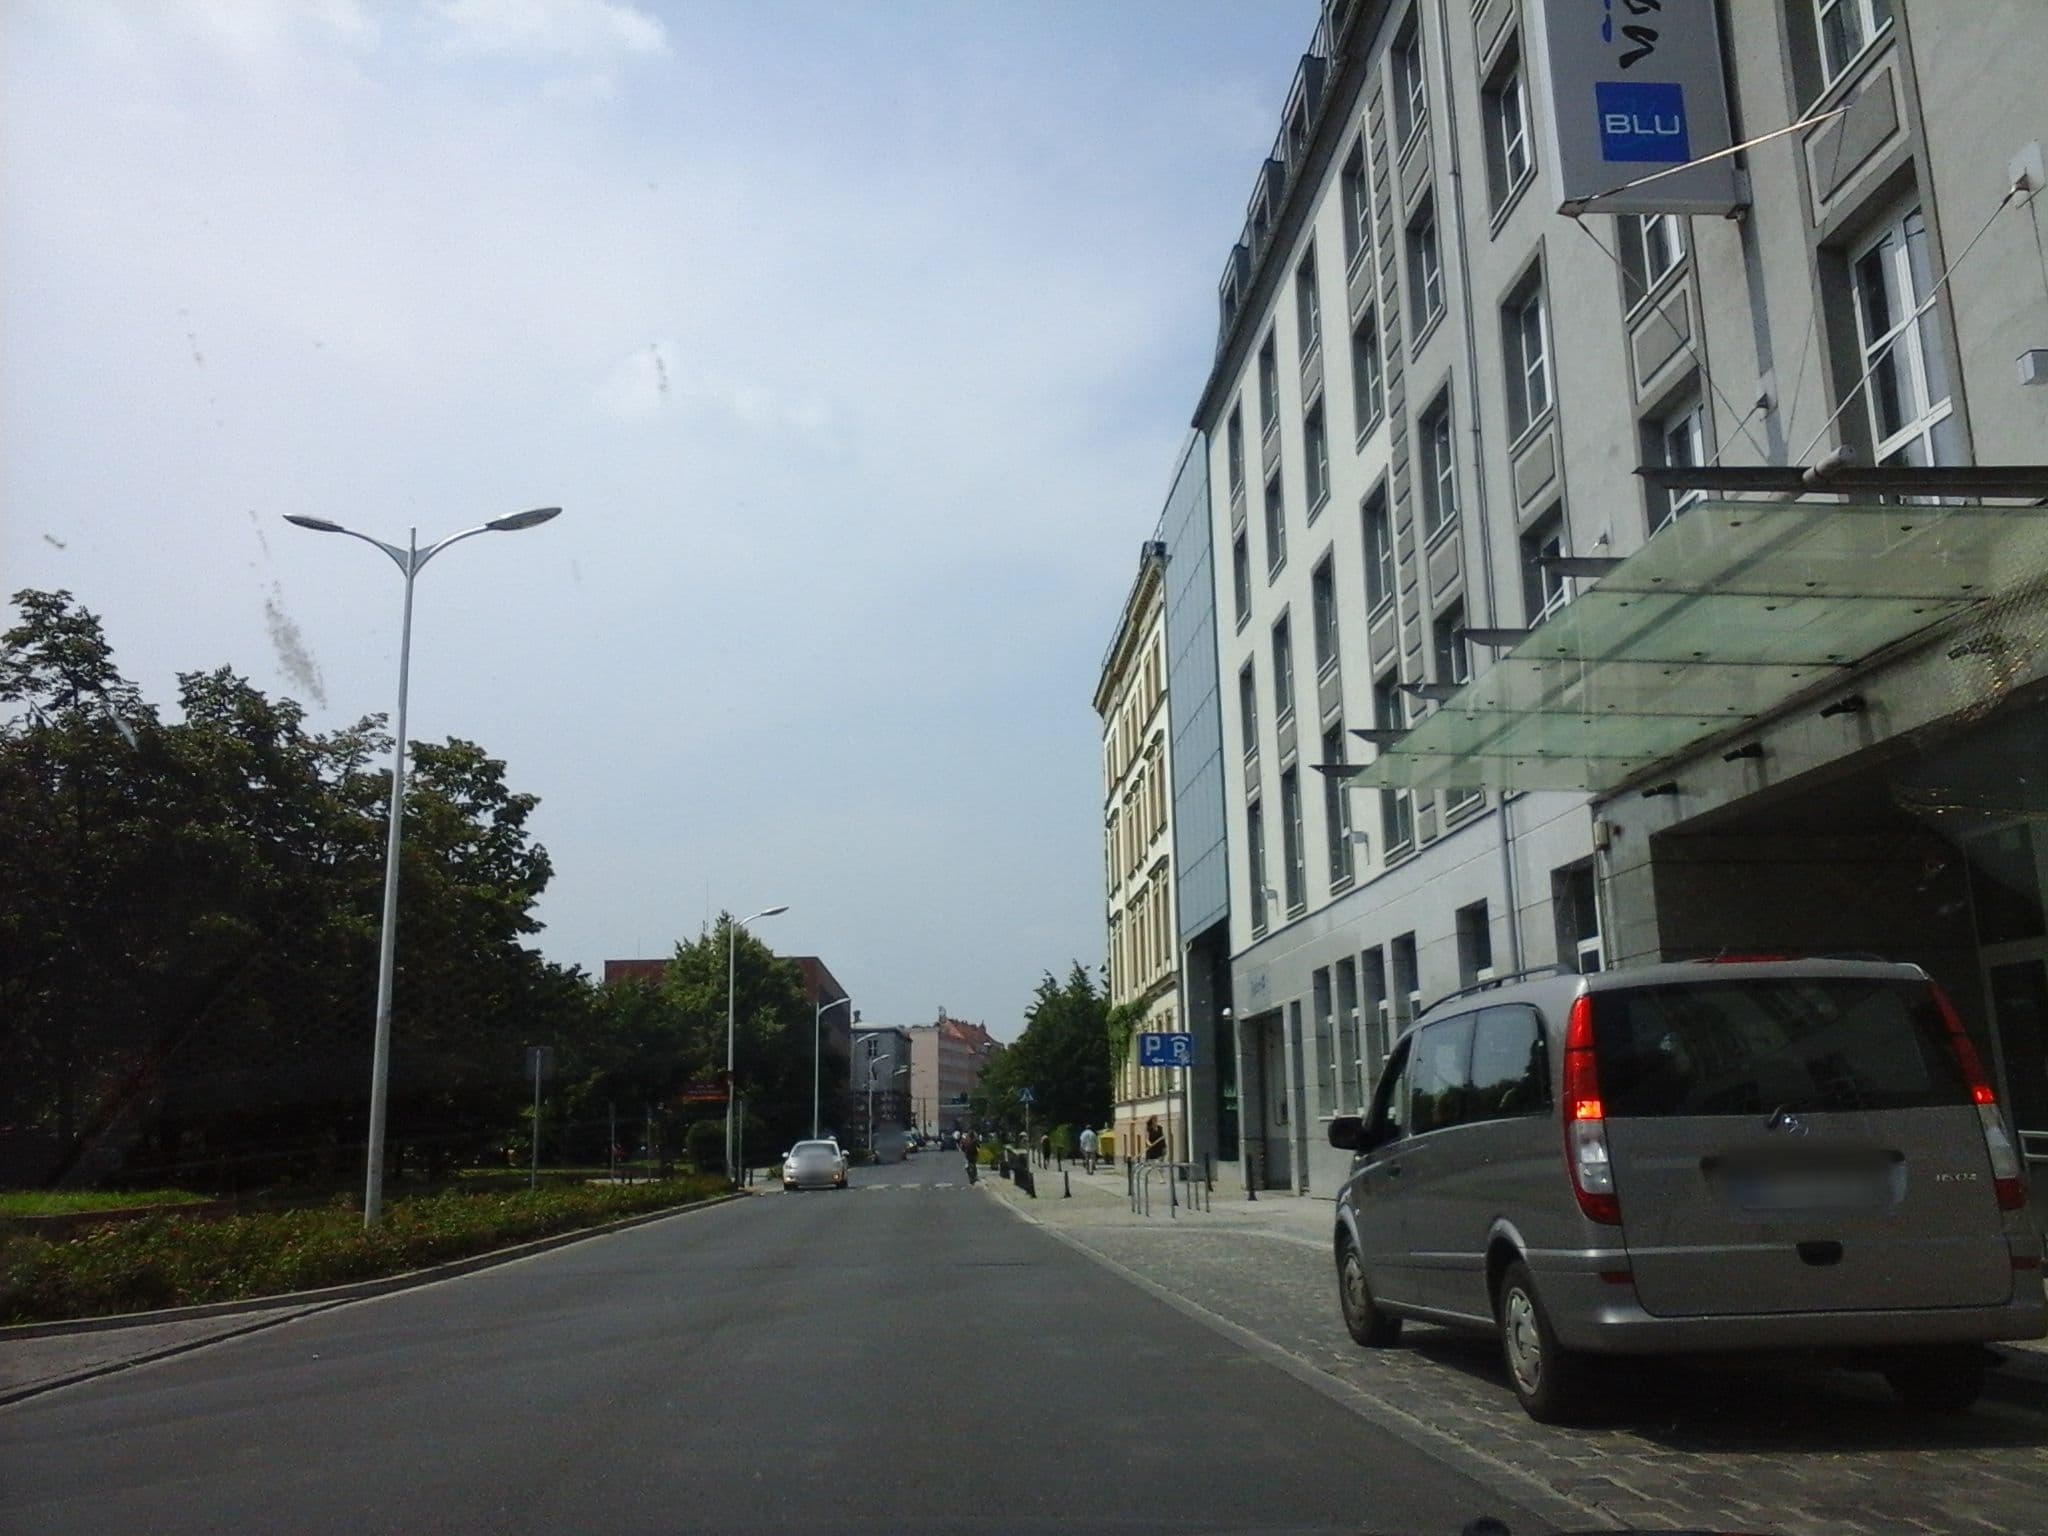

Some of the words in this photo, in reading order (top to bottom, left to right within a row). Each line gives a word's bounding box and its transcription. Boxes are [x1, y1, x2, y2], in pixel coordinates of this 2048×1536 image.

[1605, 114, 1680, 135] BLU
[1146, 1035, 1160, 1056] P
[1173, 1041, 1186, 1057] P
